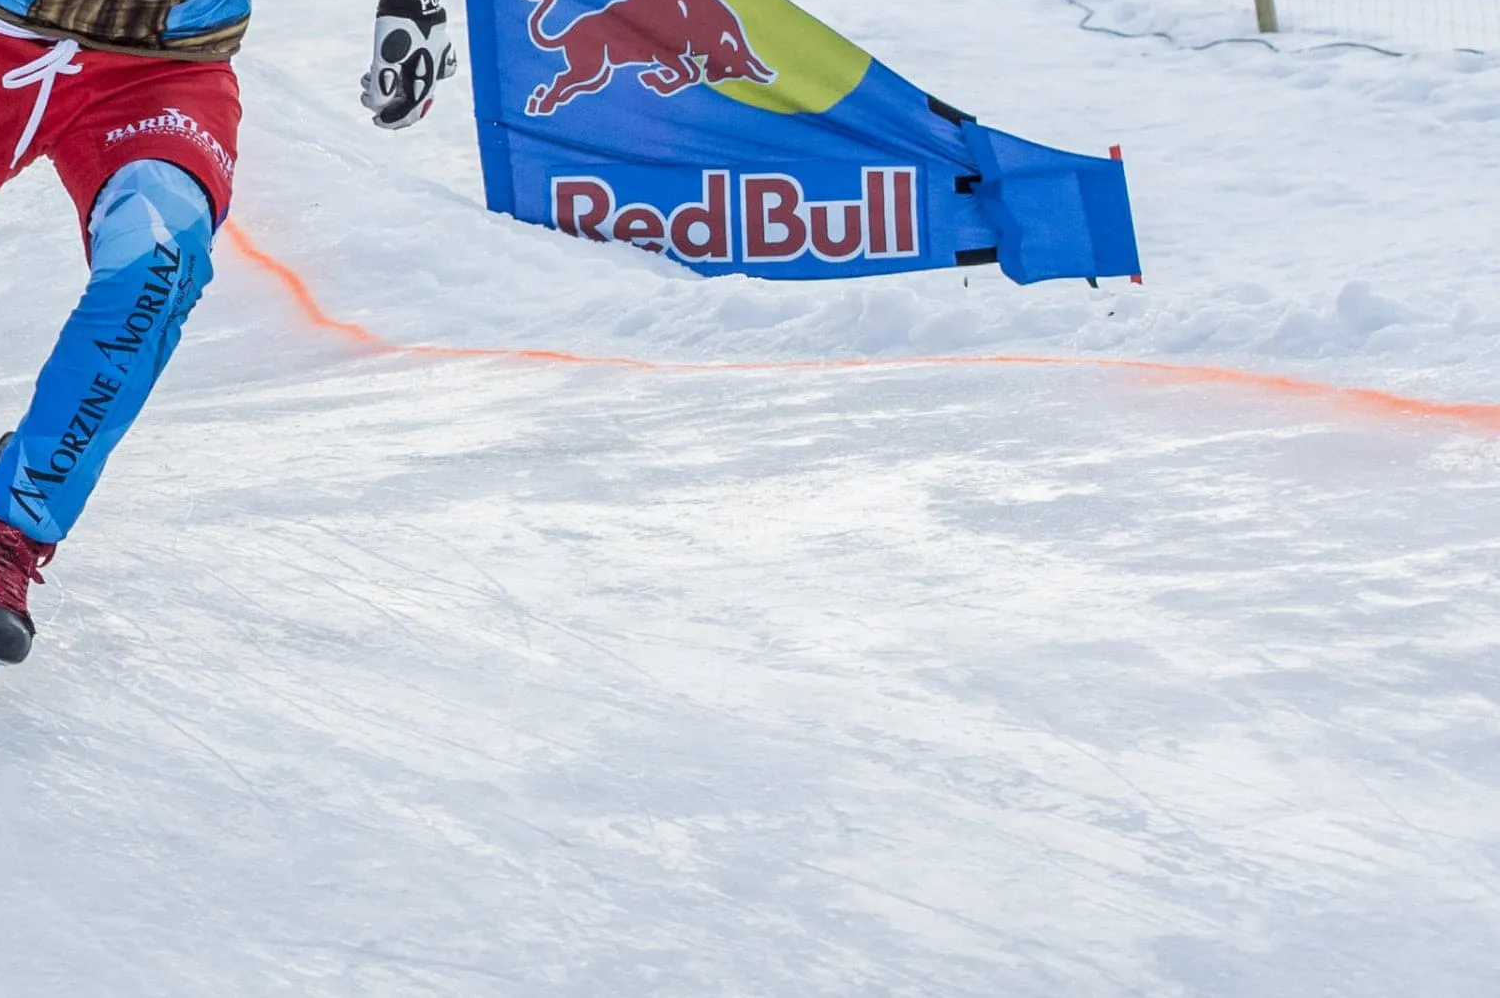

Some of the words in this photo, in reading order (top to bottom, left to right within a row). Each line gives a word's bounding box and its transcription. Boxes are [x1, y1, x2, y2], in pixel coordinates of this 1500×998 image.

[551, 168, 731, 263] Red
[738, 165, 920, 263] Bull
[9, 372, 122, 525] MORZINE
[93, 241, 181, 375] AVORIAZ
